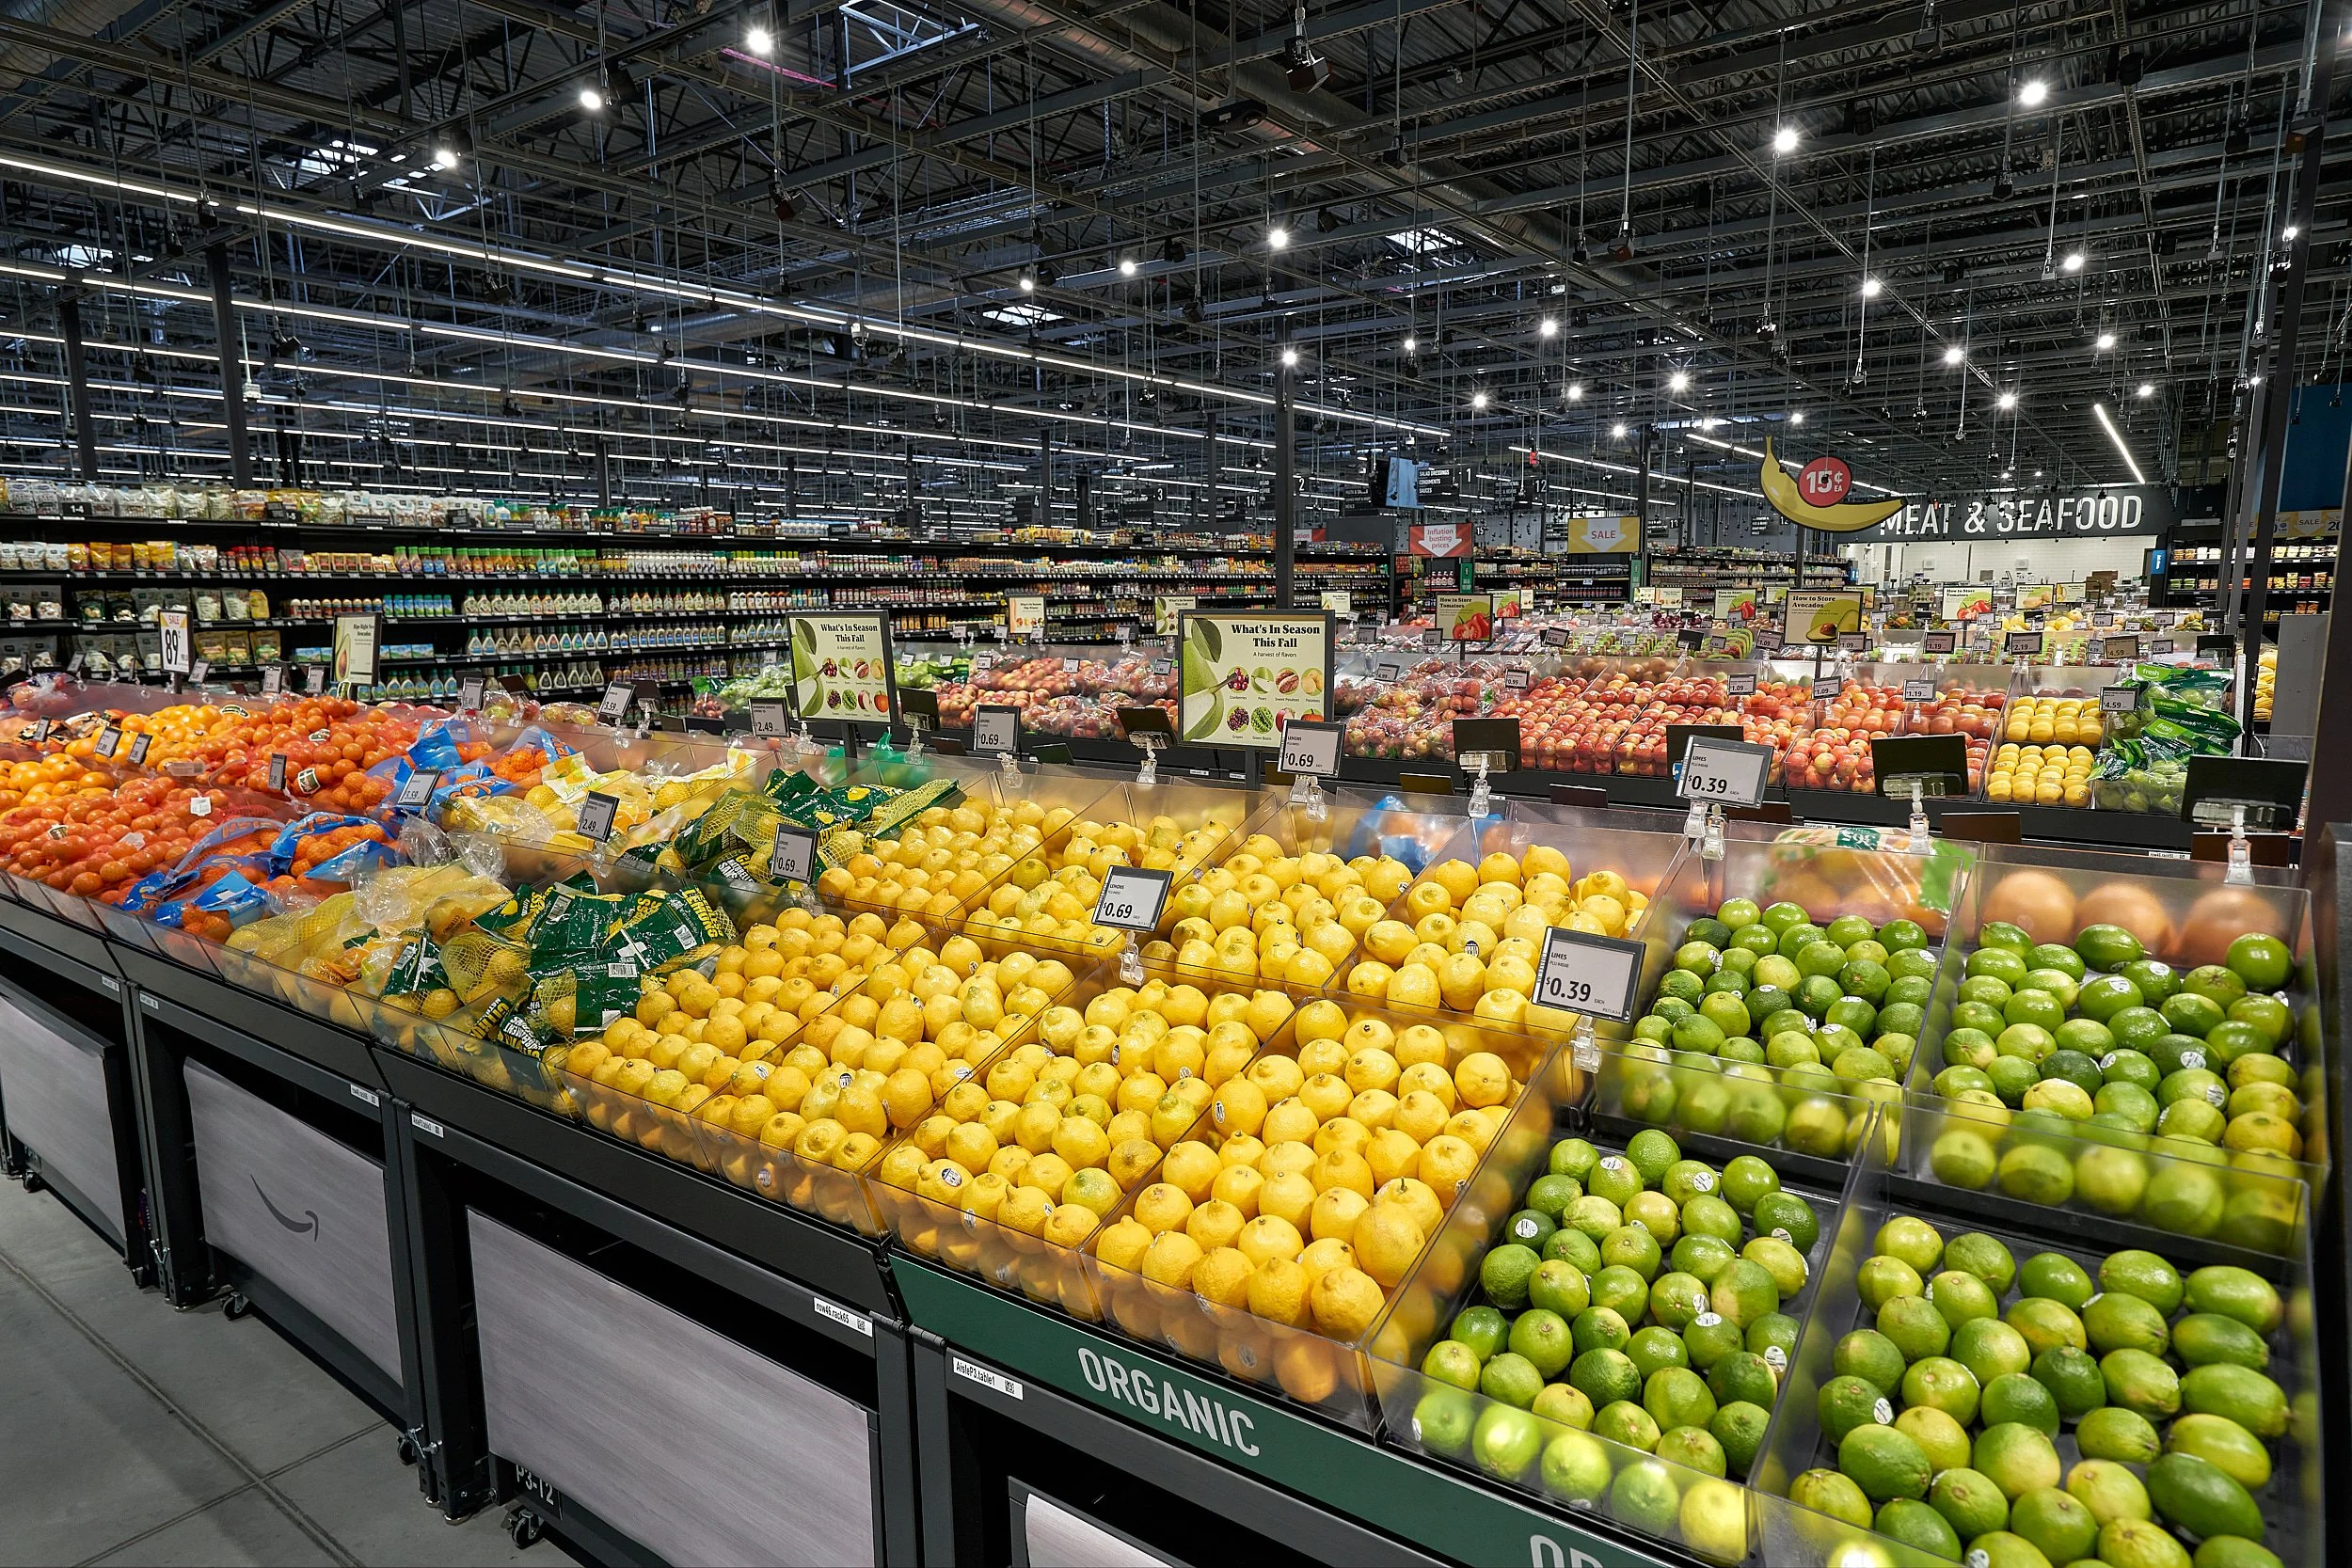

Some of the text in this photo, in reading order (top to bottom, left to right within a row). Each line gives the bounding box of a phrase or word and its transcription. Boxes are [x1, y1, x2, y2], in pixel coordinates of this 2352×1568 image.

[1466, 467, 1471, 483] 1
[1298, 478, 1305, 491] 2
[1419, 477, 1441, 485] CONDIMENTS
[1534, 479, 1547, 493] 12
[1157, 487, 1163, 500] 3
[1834, 484, 1843, 493] EA
[1879, 496, 2143, 535] MEAT & SEAFOOD
[1427, 528, 1454, 536] Inflation
[1591, 530, 1616, 540] SALE
[168, 614, 180, 625] SALE
[820, 624, 878, 632] What's In Season
[1231, 624, 1320, 635] What's In Season
[835, 634, 866, 642] This Fall
[1252, 638, 1297, 648] This Fall
[2142, 668, 2160, 676] fresh
[2156, 722, 2173, 734] fresh
[1285, 752, 1314, 768] $0.69
[1688, 775, 1727, 794] $0.39
[1103, 902, 1133, 919] $0.69
[1550, 952, 1567, 960] LIMES
[1545, 976, 1592, 1003] $0.39
[1077, 1347, 1260, 1457] ORGANIC
